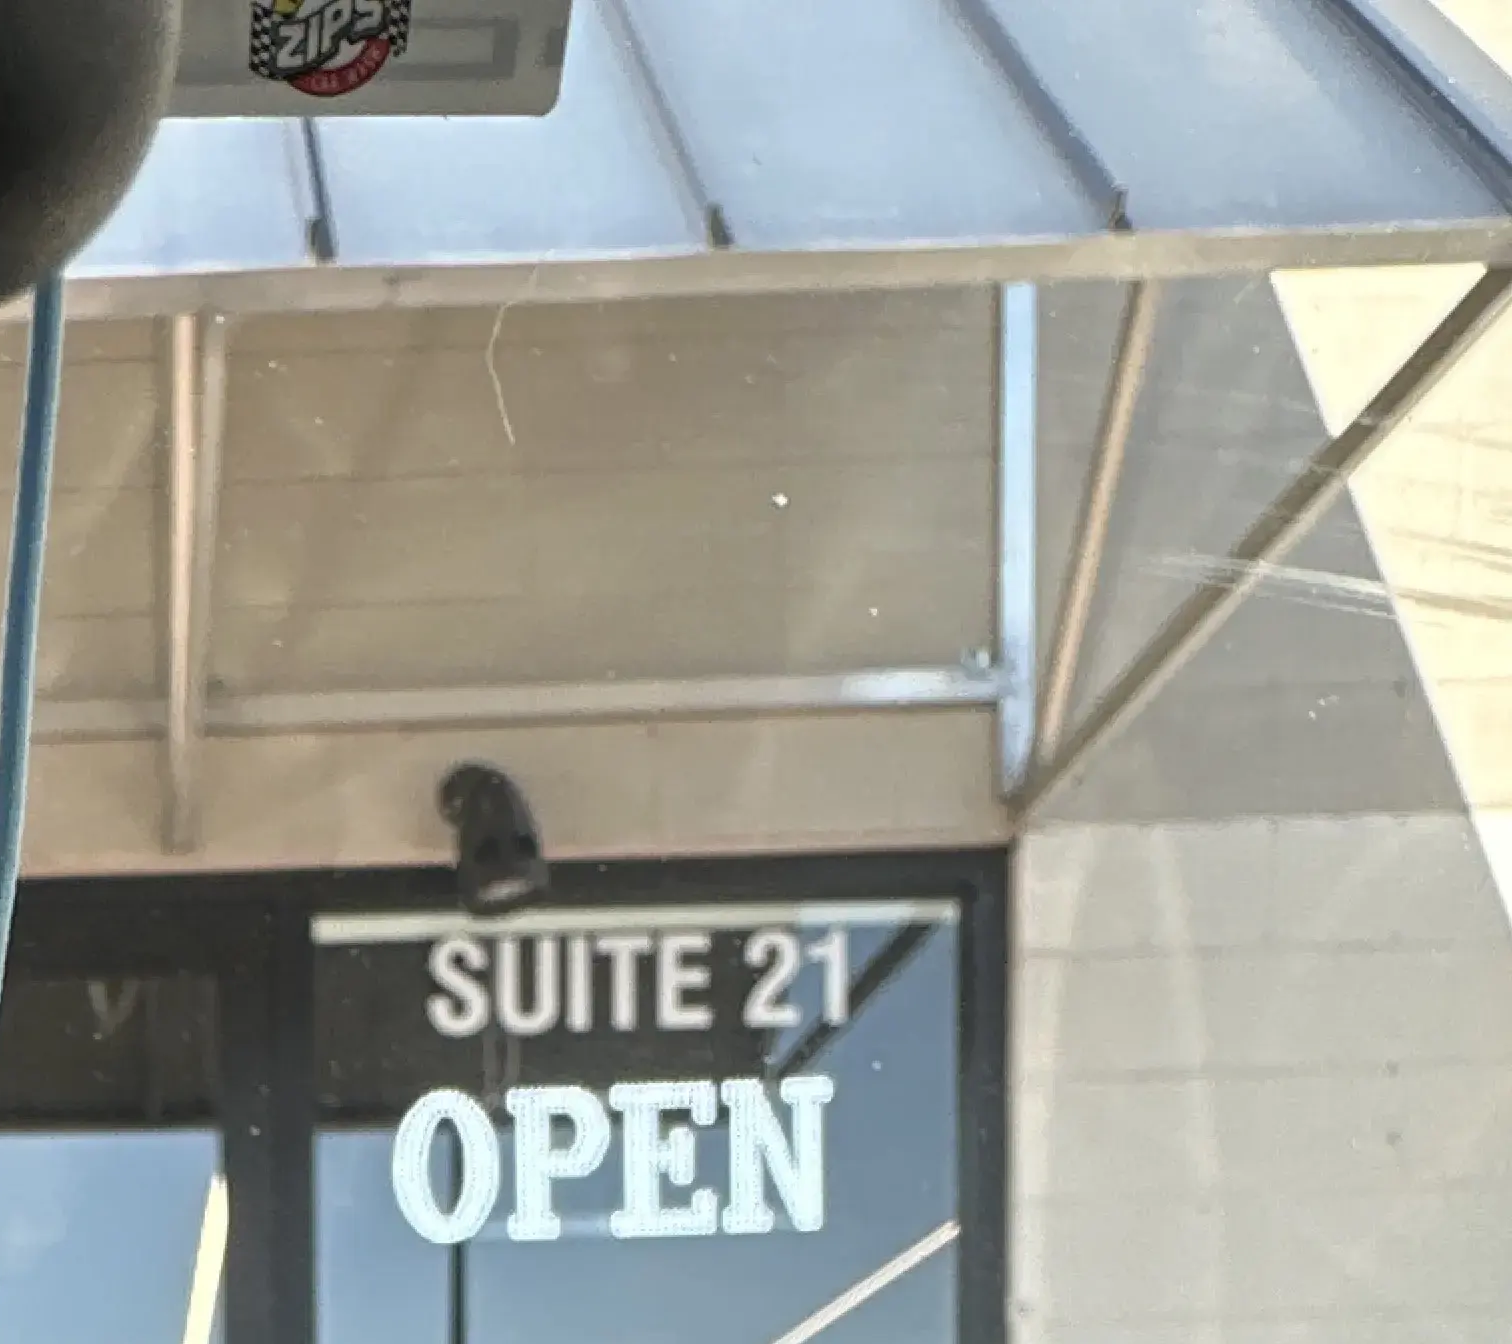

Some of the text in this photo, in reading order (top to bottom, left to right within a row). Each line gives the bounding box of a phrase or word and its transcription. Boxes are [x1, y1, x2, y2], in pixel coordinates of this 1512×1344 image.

[276, 0, 385, 68] ZIPS
[426, 928, 850, 1036] SUITE 21
[391, 1074, 834, 1244] OPEN
